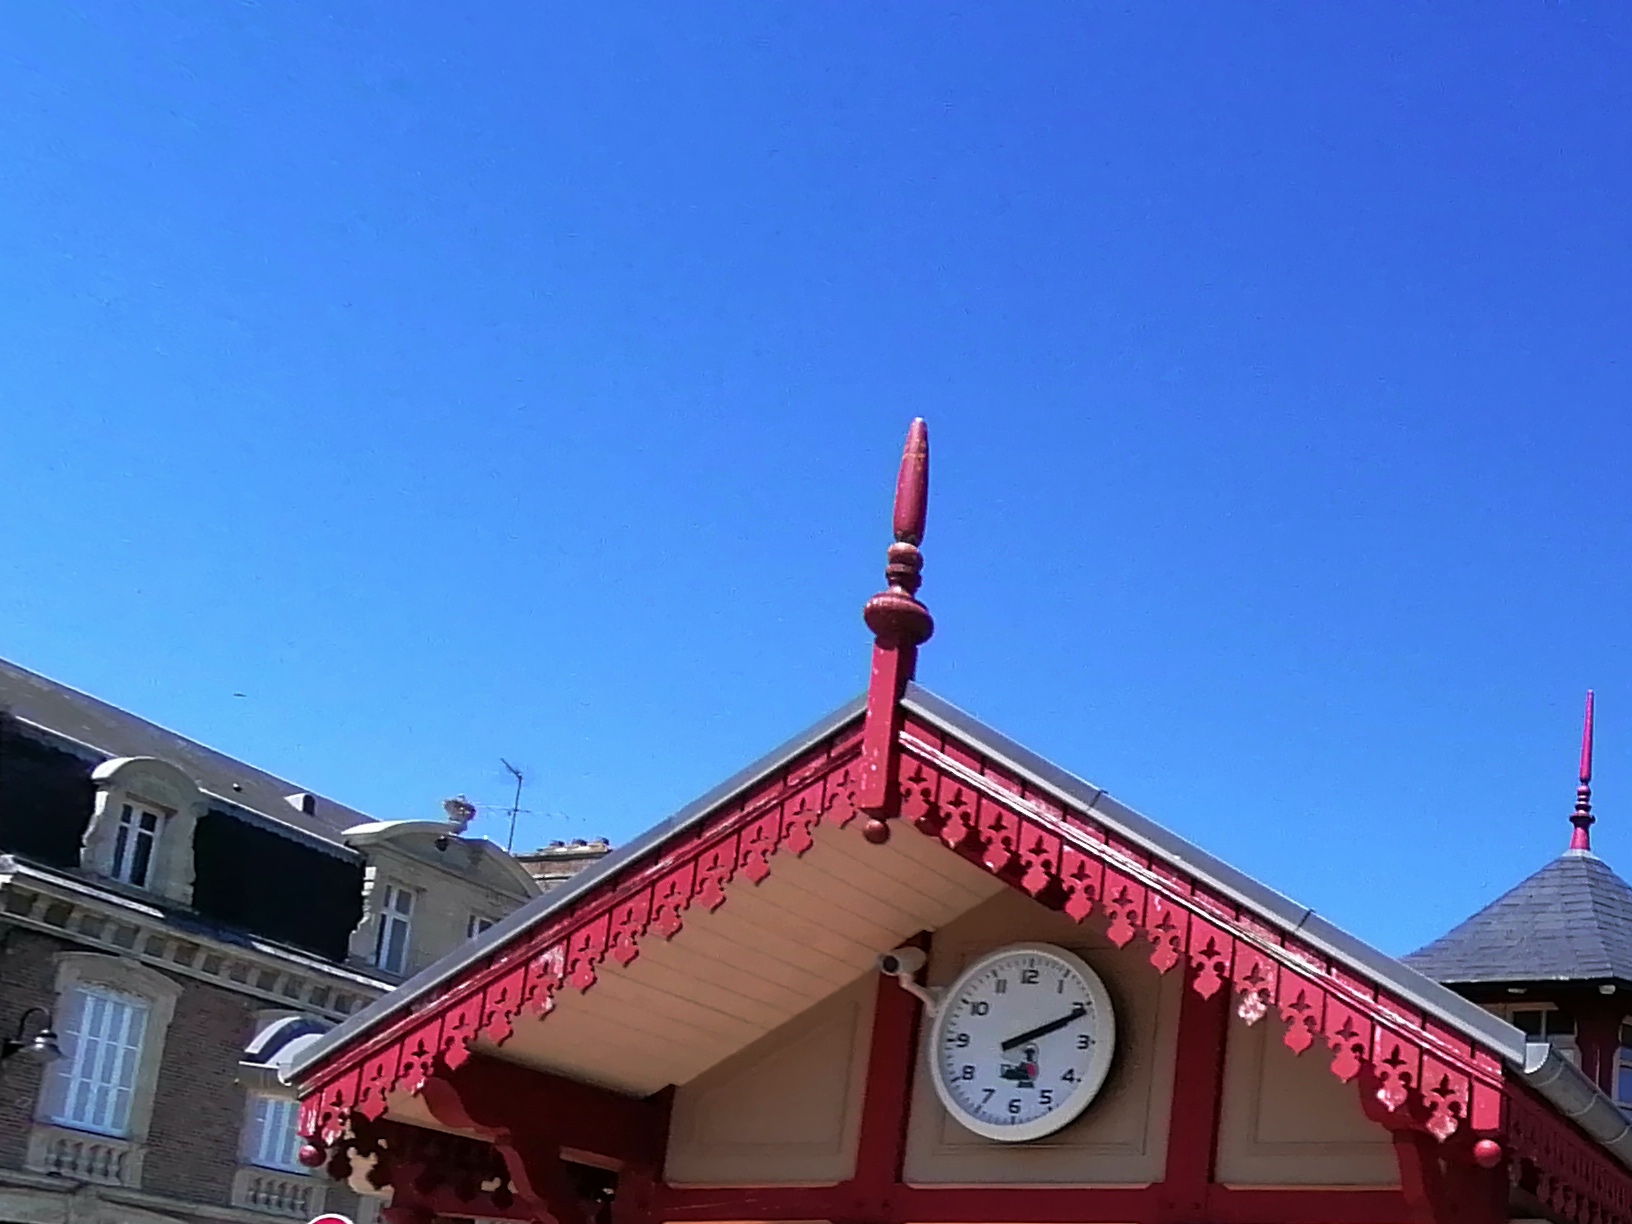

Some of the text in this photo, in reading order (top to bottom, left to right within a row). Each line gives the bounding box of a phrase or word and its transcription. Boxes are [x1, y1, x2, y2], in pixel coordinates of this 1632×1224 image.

[1020, 969, 1039, 985] 12
[995, 979, 1007, 994] 11
[1057, 979, 1064, 994] 1
[970, 1001, 989, 1016] 10
[957, 1033, 970, 1048] 9
[1077, 1034, 1090, 1050] 3
[962, 1065, 975, 1080] 8
[1060, 1069, 1075, 1084] 4
[982, 1088, 996, 1104] 7
[1040, 1089, 1053, 1105] 5
[1009, 1099, 1021, 1114] 6
